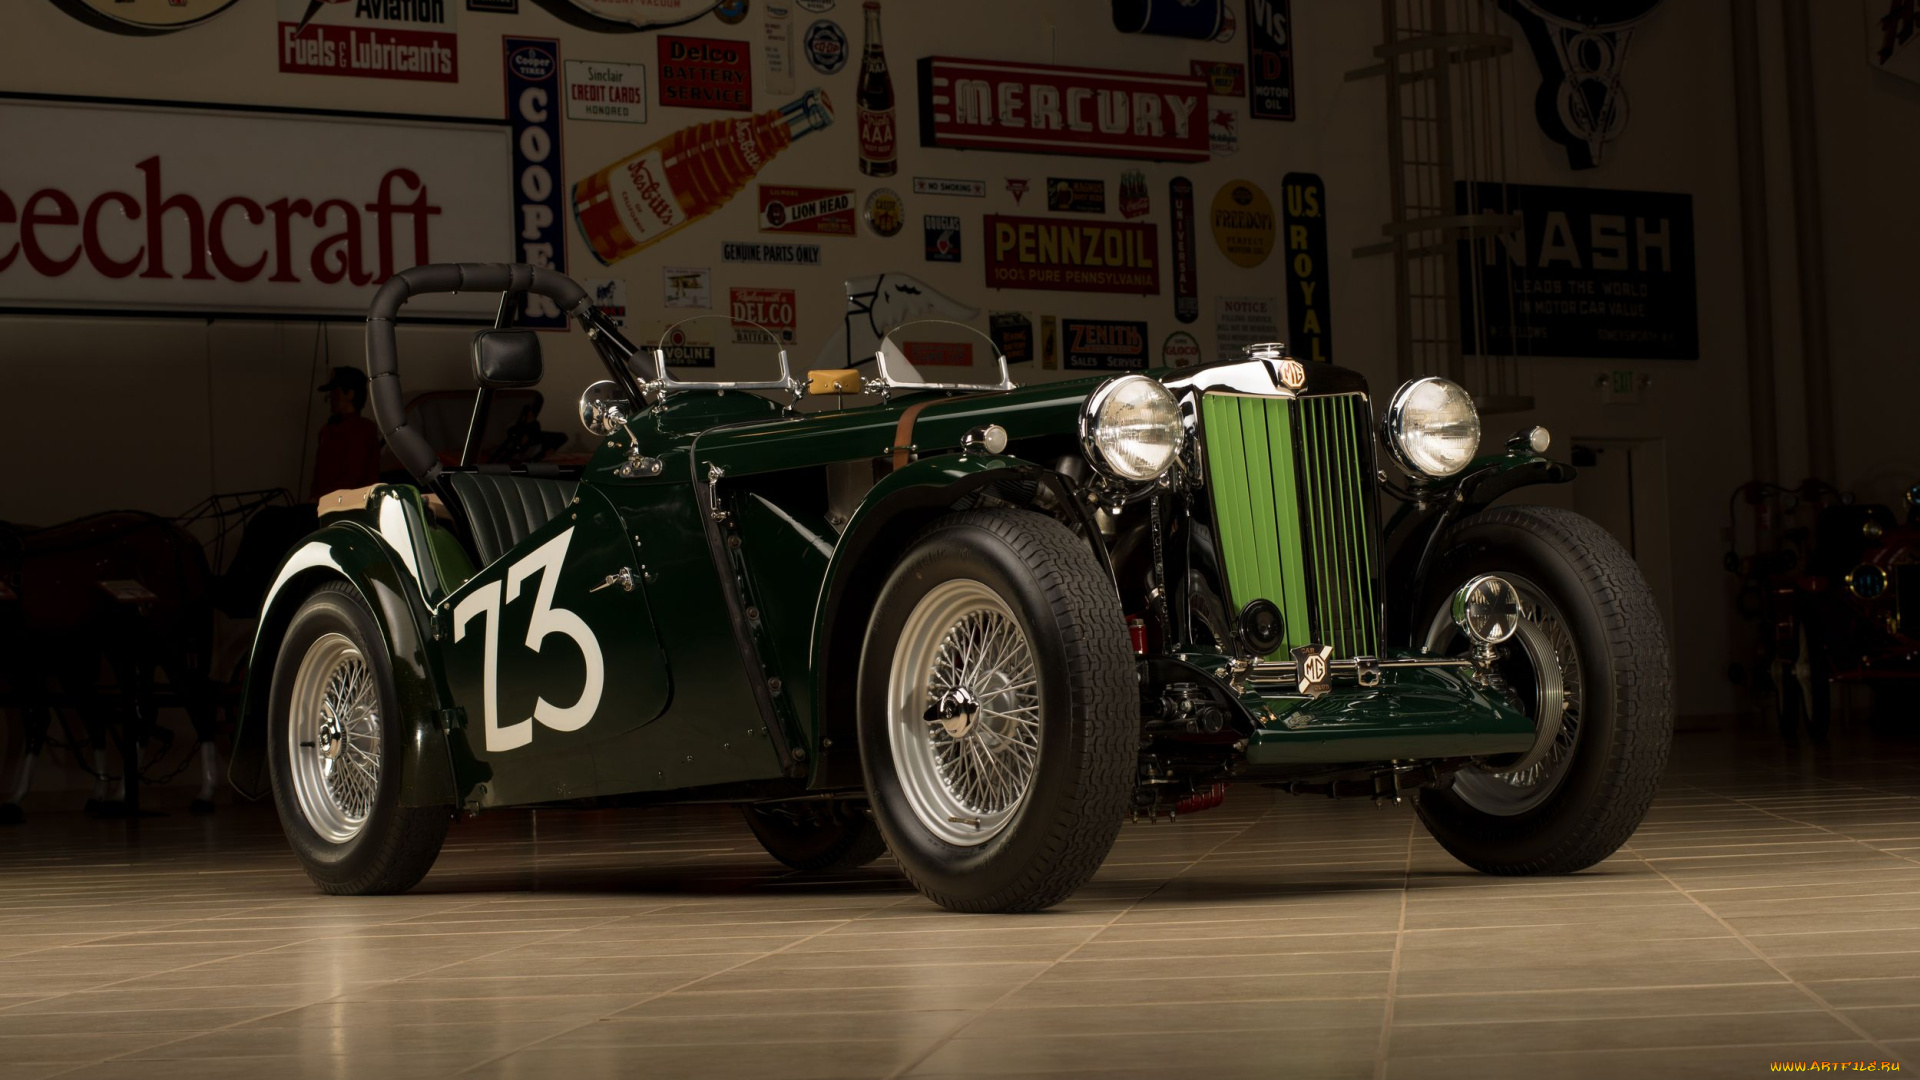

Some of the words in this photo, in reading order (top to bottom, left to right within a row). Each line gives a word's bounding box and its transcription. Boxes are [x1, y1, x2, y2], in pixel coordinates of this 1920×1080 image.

[355, 0, 445, 23] Aviation
[283, 25, 337, 67] Fuels
[350, 29, 453, 75] Lubricants
[670, 42, 739, 63] Delco
[515, 54, 551, 68] Cooper
[1263, 51, 1281, 80] D
[588, 67, 624, 83] Sinclair
[662, 66, 746, 84] BATTERY
[571, 84, 606, 102] CREDIT
[608, 86, 641, 105] CARDS
[666, 84, 745, 104] SERVICE
[1256, 86, 1289, 99] MOTOR
[585, 105, 630, 117] HONORED
[954, 78, 1198, 140] MERCURY
[1264, 98, 1282, 111] OIL
[861, 123, 893, 144] AAA
[928, 181, 940, 191] NO
[940, 183, 973, 193] SMOKING
[519, 87, 561, 319] COOPER
[791, 202, 816, 221] LION
[819, 195, 849, 213] HEAD
[1214, 209, 1273, 231] FREEDOM
[994, 221, 1154, 269] PENNZOIL
[1175, 199, 1188, 295] UNIVERSAL
[1225, 236, 1265, 246] PERFECT
[1481, 207, 1672, 274] NASH
[723, 244, 761, 262] GENUINE
[762, 246, 794, 262] PARTS
[795, 246, 820, 264] ONLY
[994, 268, 1026, 281] 100%
[1028, 269, 1061, 283] PURE
[1065, 271, 1154, 286] PENNSYLVANIA
[1288, 224, 1327, 362] ROYAL
[1514, 280, 1563, 294] LEADS
[1567, 280, 1596, 295] THE
[1602, 281, 1649, 298] WORLD
[733, 302, 793, 325] DELCO
[1224, 301, 1269, 313] NOTICE
[1534, 301, 1577, 315] MOTOR
[1578, 301, 1607, 316] CAR
[1608, 301, 1647, 318] VALUE
[1069, 323, 1144, 355] ZENITH
[647, 347, 711, 361] HVOLINE
[1071, 354, 1098, 367] SALES
[1106, 355, 1143, 369] SERVICE
[1284, 362, 1303, 385] MG
[1612, 370, 1635, 394] EXIT
[1305, 657, 1324, 681] MG
